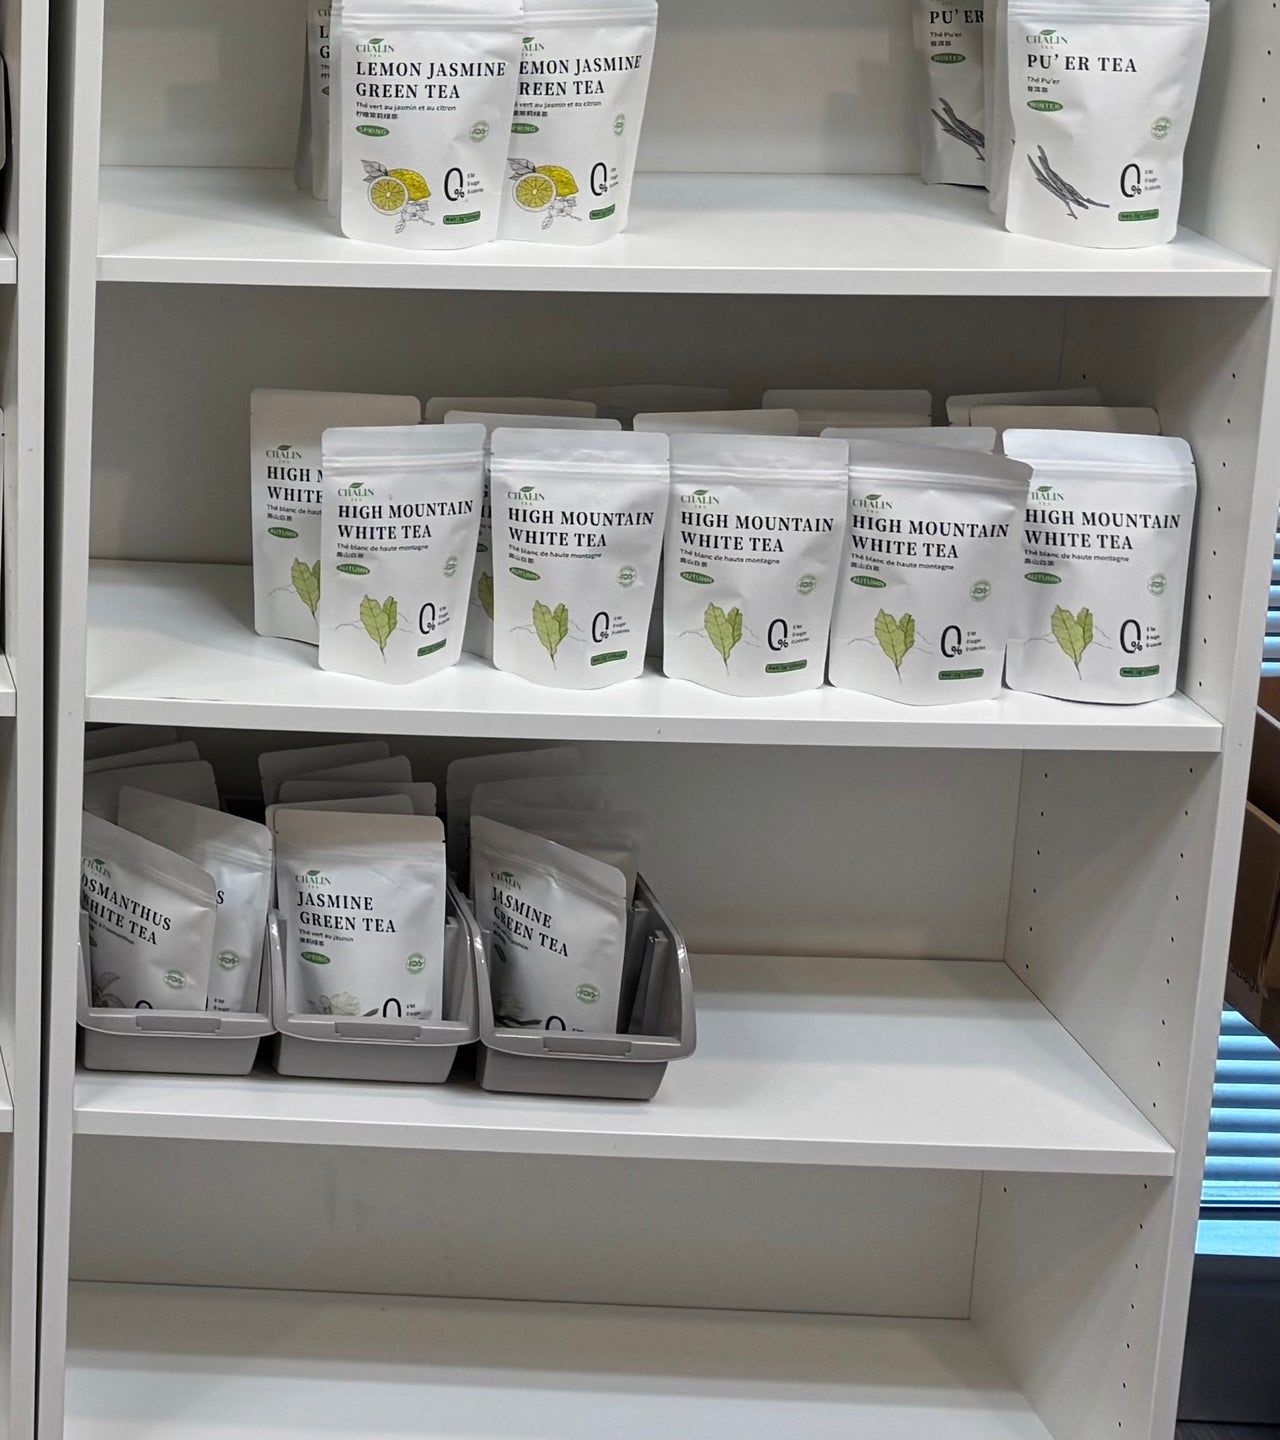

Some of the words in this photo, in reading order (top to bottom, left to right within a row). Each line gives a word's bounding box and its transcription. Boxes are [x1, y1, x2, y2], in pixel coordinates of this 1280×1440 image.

[356, 61, 422, 76] LEMON
[427, 62, 506, 79] JASMINE
[1098, 57, 1137, 72] TEA
[356, 83, 418, 98] GREEN
[425, 84, 460, 98] TEA
[853, 515, 902, 534] HIGH
[909, 520, 1009, 539] MOUNTAIN
[851, 535, 917, 556] WHITE
[923, 542, 959, 558] TEA
[853, 578, 884, 587] AUTUMN
[82, 873, 172, 931] OSMANTHUS
[297, 892, 373, 910] JASMINE
[129, 919, 157, 945] TEA
[300, 911, 356, 930] GREEN
[362, 918, 396, 933] TEA
